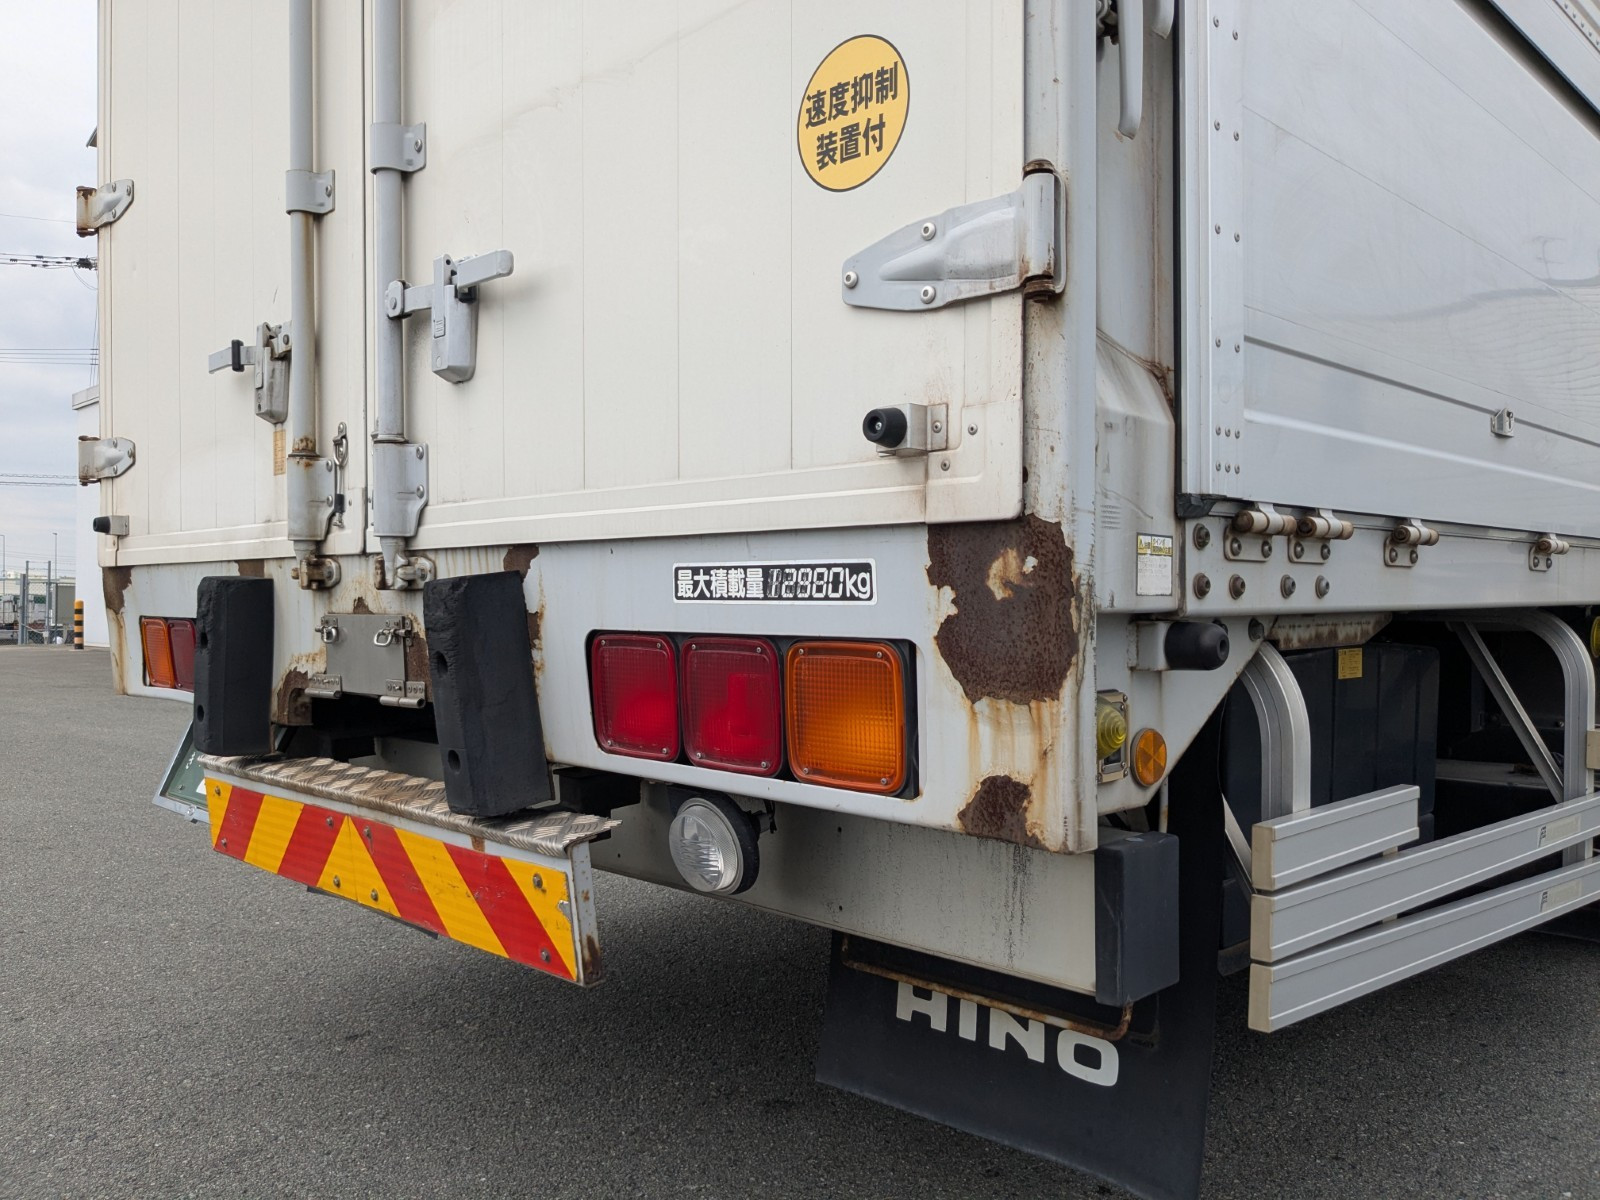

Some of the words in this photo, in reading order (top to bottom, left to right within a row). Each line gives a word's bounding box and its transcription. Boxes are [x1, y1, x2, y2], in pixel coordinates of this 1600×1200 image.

[805, 61, 898, 129] 速度抑制
[816, 113, 886, 171] 装置付
[896, 981, 1119, 1087] HINO
